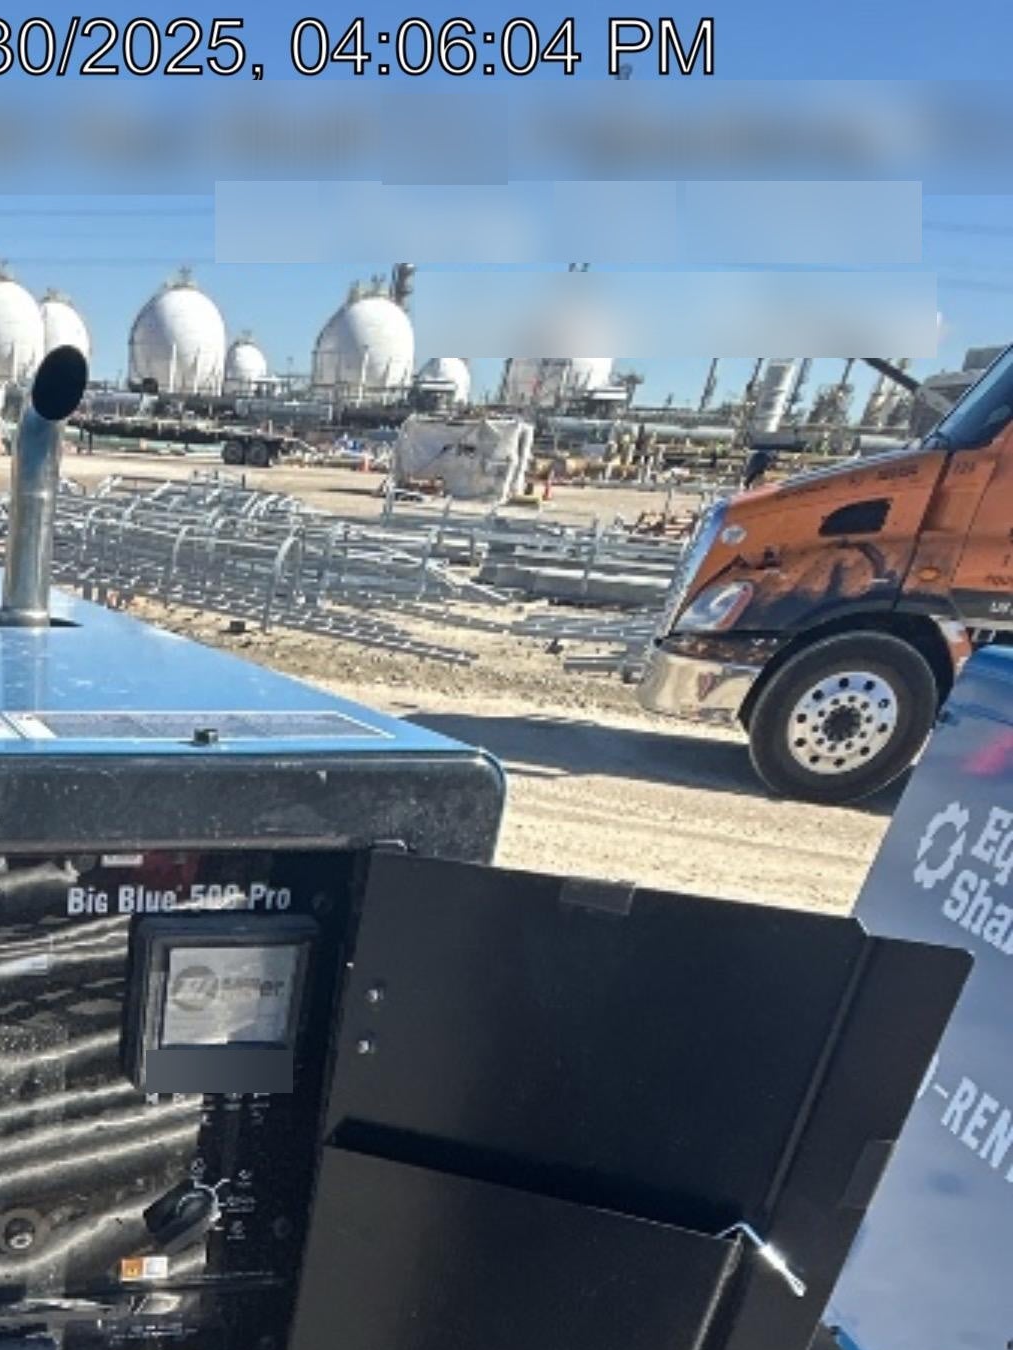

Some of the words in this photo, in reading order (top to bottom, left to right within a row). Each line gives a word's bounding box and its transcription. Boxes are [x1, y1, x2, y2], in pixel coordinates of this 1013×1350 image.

[67, 885, 109, 915] Big
[118, 884, 177, 914] Blue
[248, 881, 292, 910] Pro
